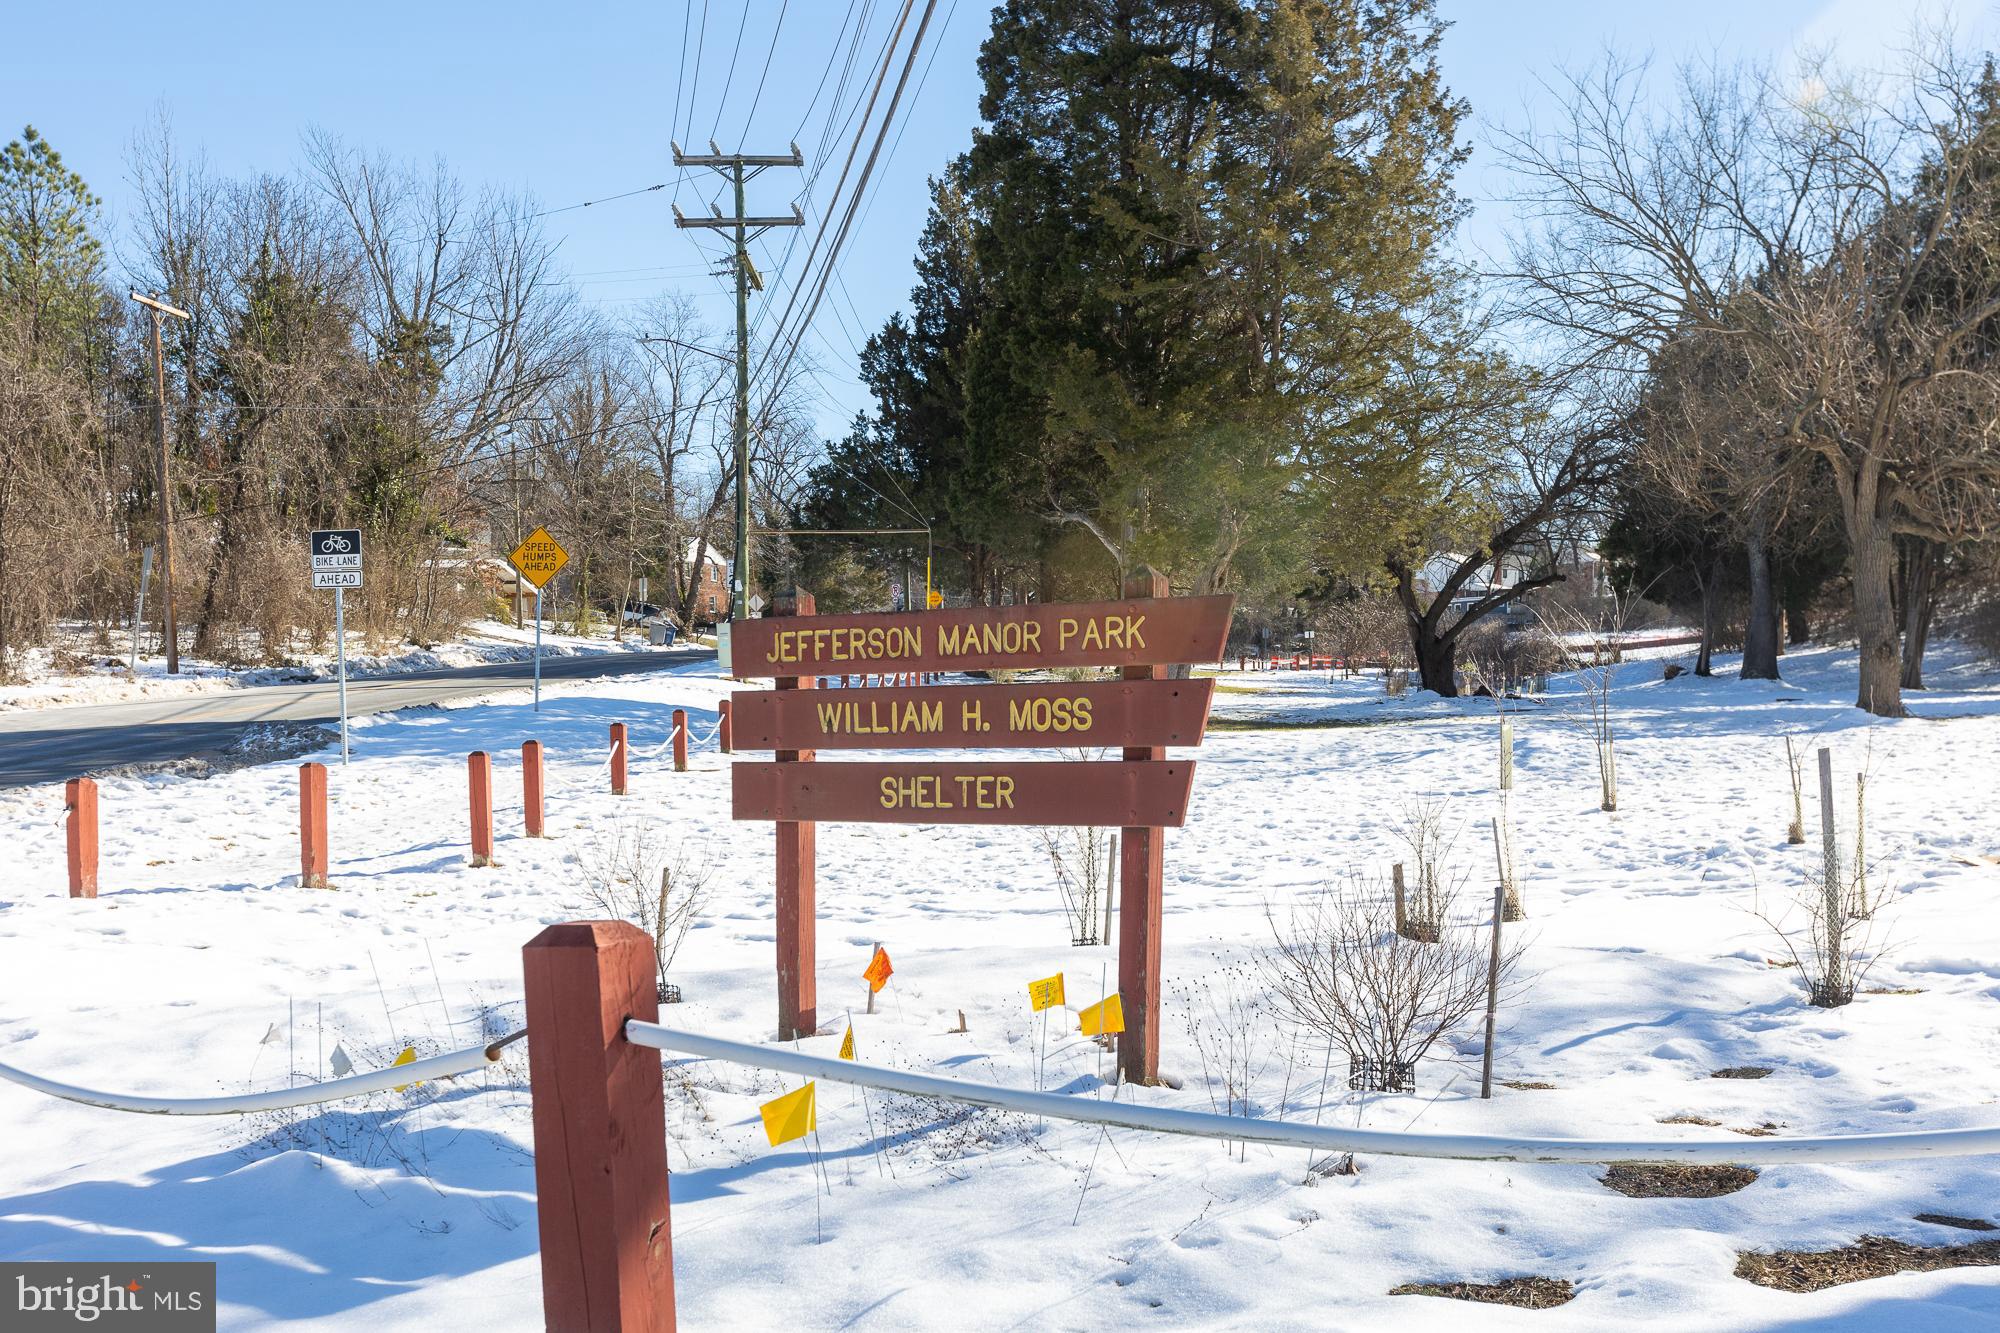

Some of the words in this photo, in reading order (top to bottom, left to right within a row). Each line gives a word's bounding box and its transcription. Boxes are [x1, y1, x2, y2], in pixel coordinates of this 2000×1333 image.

[525, 542, 556, 552] SPEED
[316, 557, 333, 566] BIKE
[337, 556, 358, 566] LANE
[522, 552, 557, 561] HUMPS
[523, 562, 556, 571] AHEAD
[319, 574, 356, 585] AHEAD
[766, 625, 922, 663] JEFFERSON
[938, 621, 1041, 656] MANOR
[1059, 615, 1146, 652] PARK
[817, 701, 943, 734] WILLIAM
[962, 700, 991, 732] H.
[1009, 697, 1093, 732] MOSS
[880, 776, 1014, 809] SHELTER
